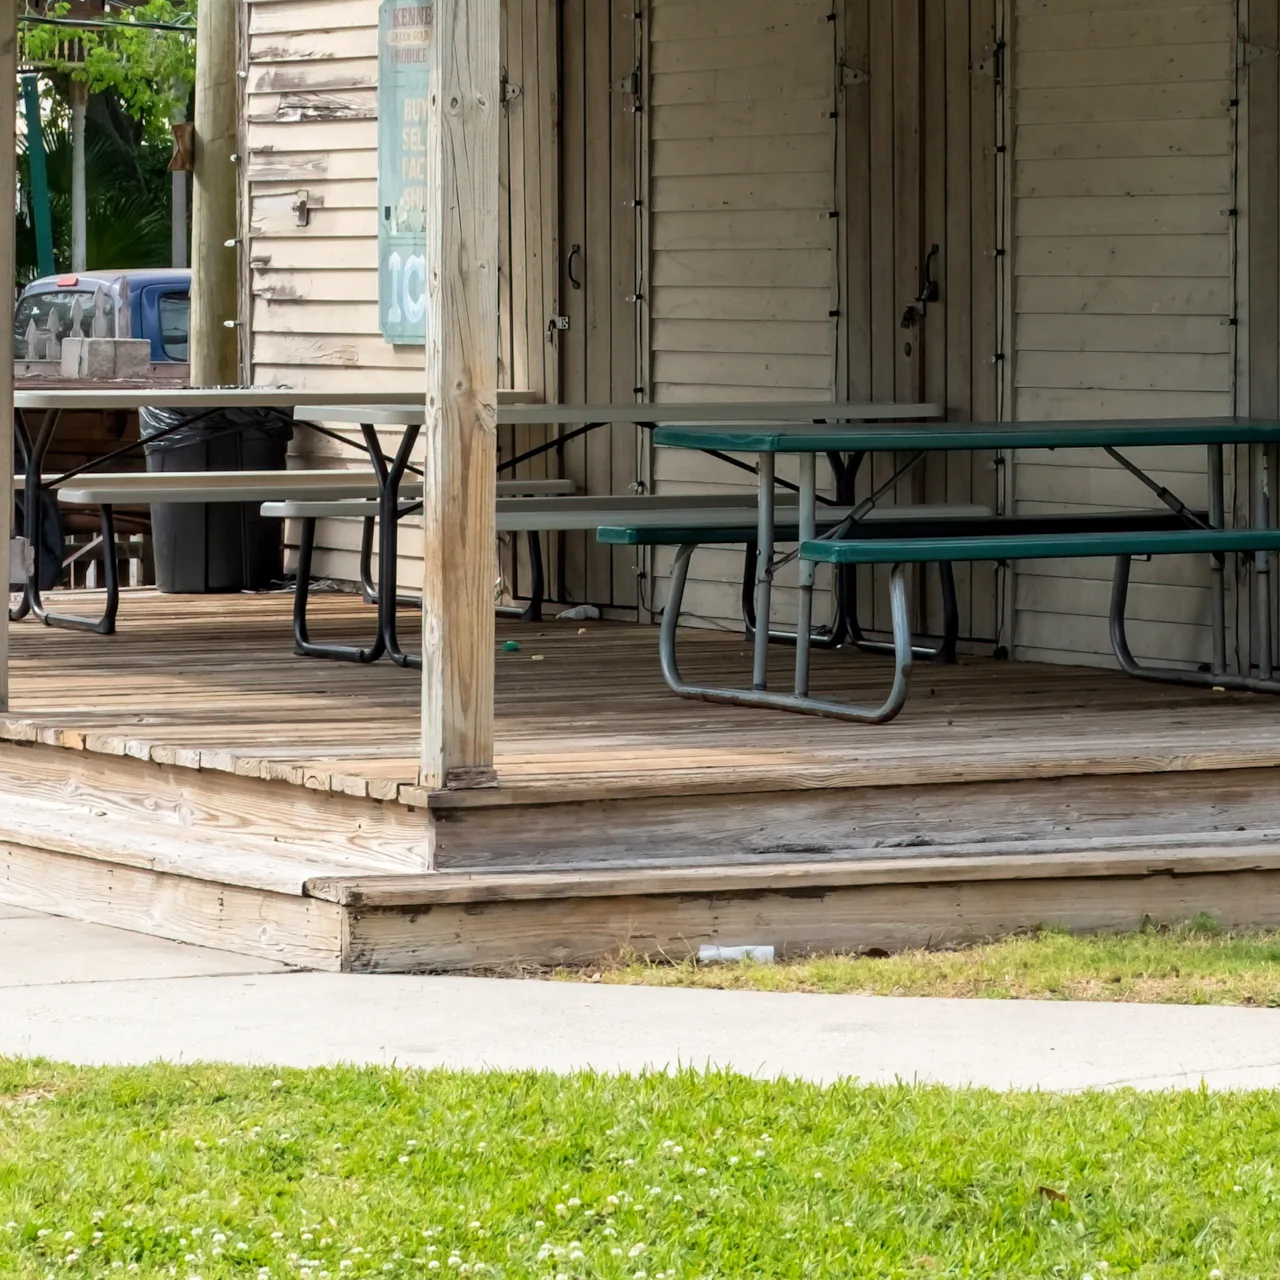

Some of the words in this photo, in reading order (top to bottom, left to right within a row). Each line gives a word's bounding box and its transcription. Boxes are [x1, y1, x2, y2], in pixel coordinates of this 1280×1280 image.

[393, 6, 432, 28] KENNE
[401, 127, 426, 150] SEL
[401, 157, 426, 182] PAC
